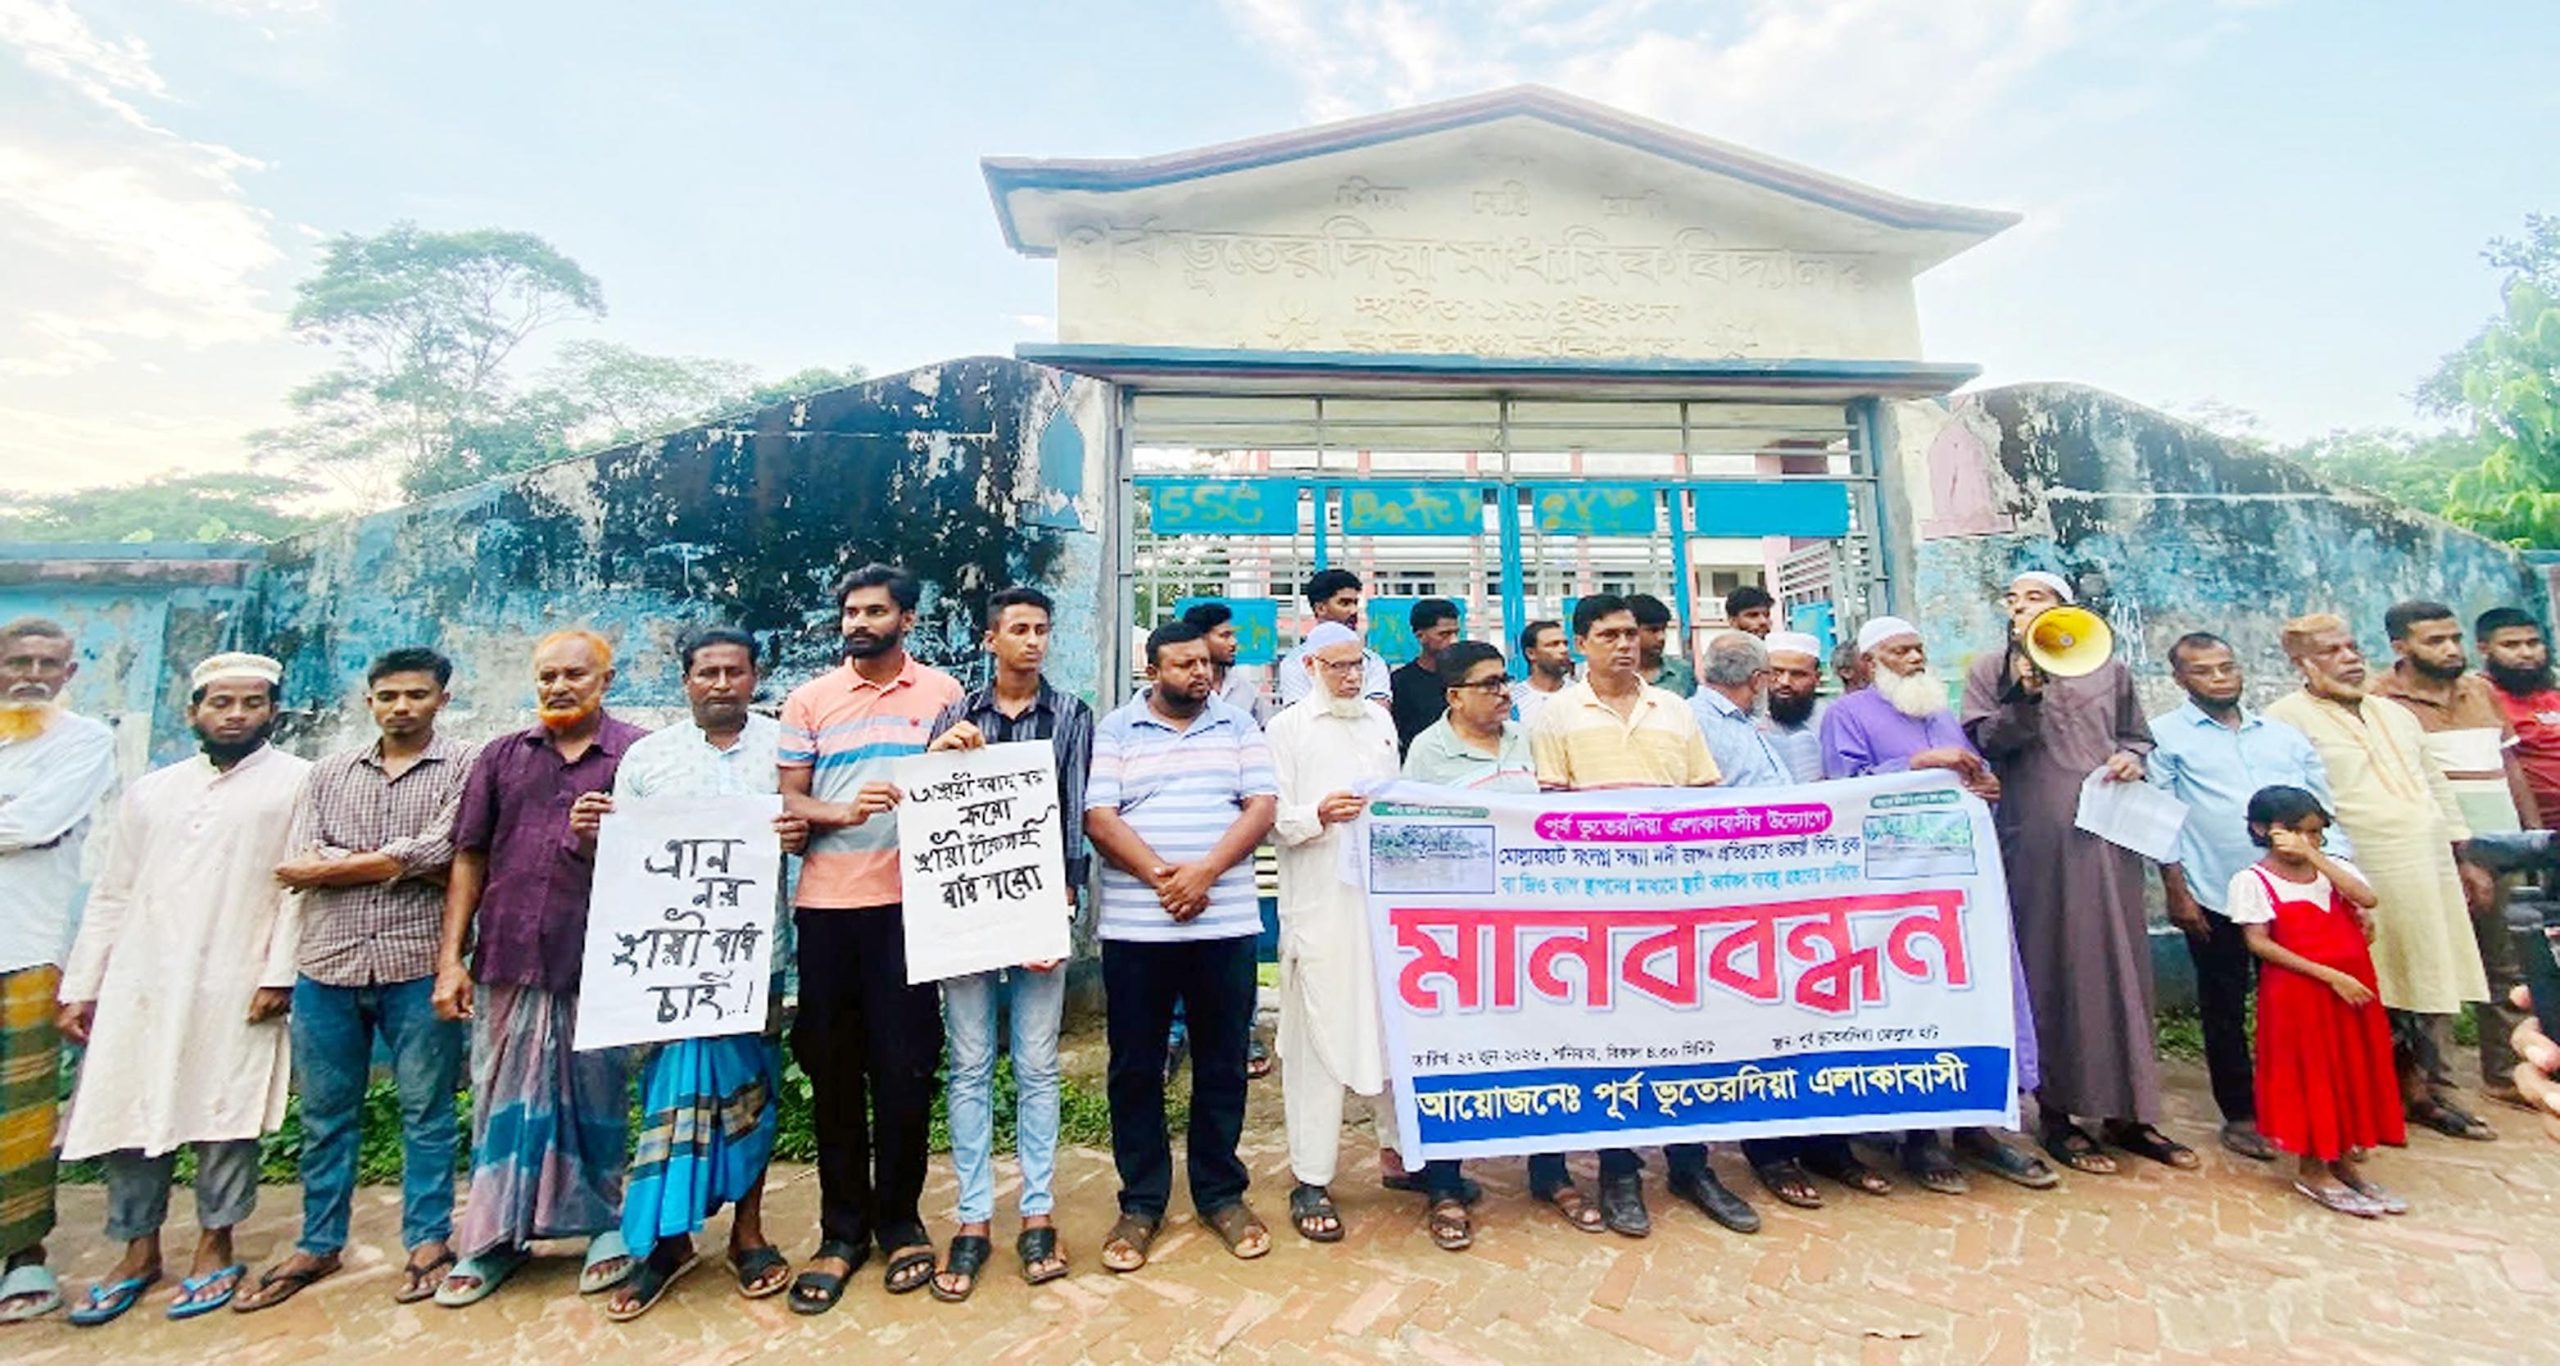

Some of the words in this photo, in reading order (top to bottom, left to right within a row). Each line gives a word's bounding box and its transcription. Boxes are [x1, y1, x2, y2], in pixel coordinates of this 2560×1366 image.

[1389, 890, 1966, 1014] মানববন্ধন
[1593, 1071, 1645, 1121] পূর্ব
[1649, 1064, 1798, 1118] ভূতেরদিয়া
[1809, 1052, 1969, 1097] এলাকাবাসী
